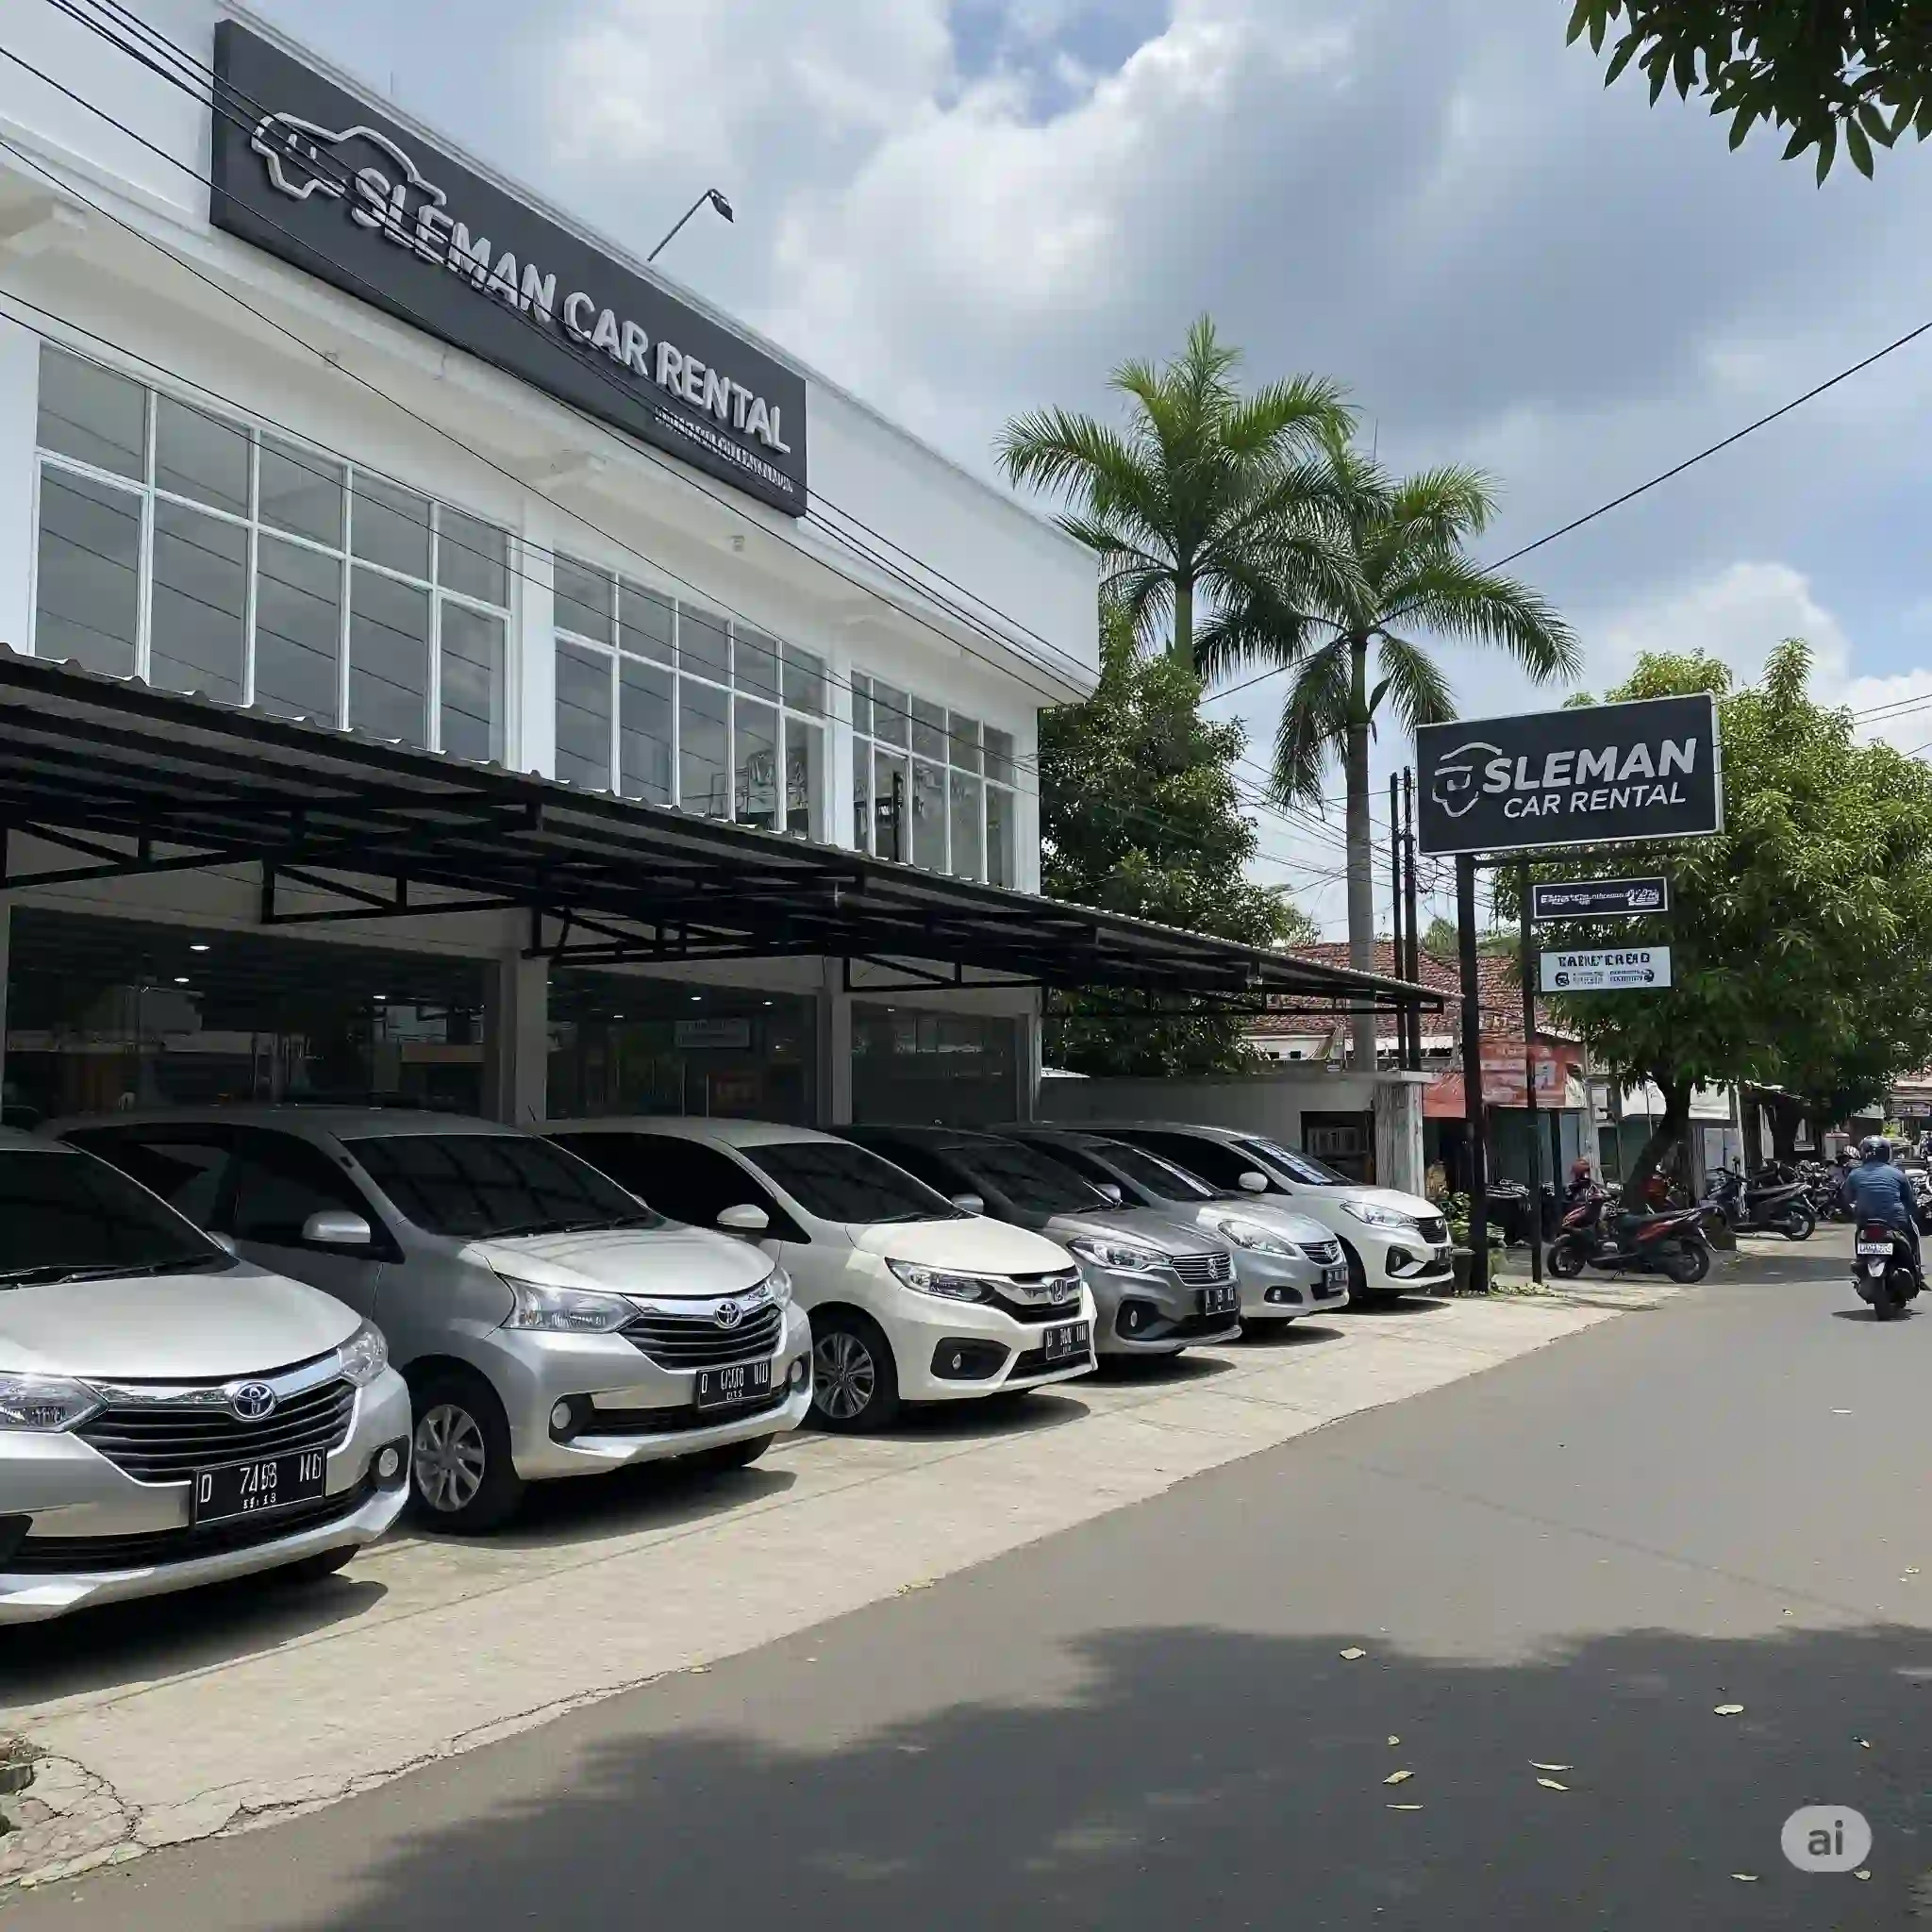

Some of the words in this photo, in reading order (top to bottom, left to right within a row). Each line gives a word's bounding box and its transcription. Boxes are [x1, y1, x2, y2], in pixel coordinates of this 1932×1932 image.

[350, 166, 557, 322] SLEMAN
[563, 291, 649, 376] CAR
[657, 341, 791, 454] RENTAL
[1482, 738, 1697, 793] SLEMAN
[1504, 793, 1560, 818] CAR
[1569, 782, 1686, 813] RENTAL
